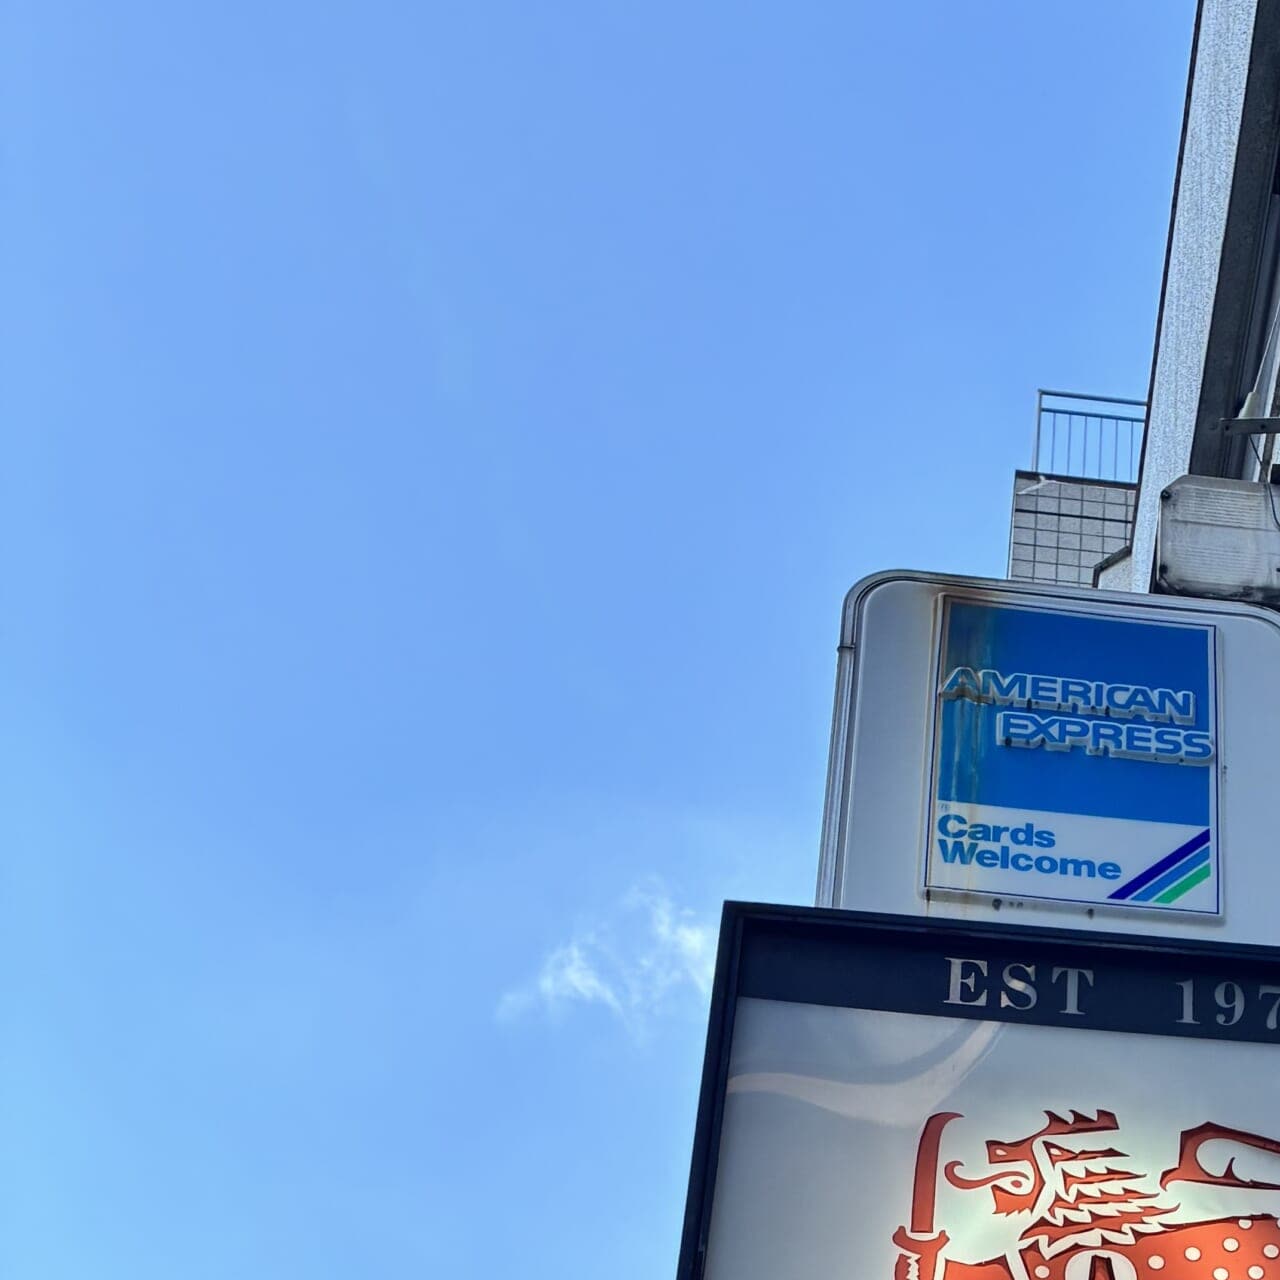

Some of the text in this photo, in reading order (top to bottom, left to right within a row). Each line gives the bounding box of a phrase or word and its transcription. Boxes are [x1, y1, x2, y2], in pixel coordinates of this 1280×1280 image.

[940, 668, 1195, 722] AMERICAN
[999, 712, 1213, 761] EXPRESS
[937, 814, 1056, 849] Cards
[937, 839, 1122, 881] Welcome
[943, 957, 1094, 1015] EST
